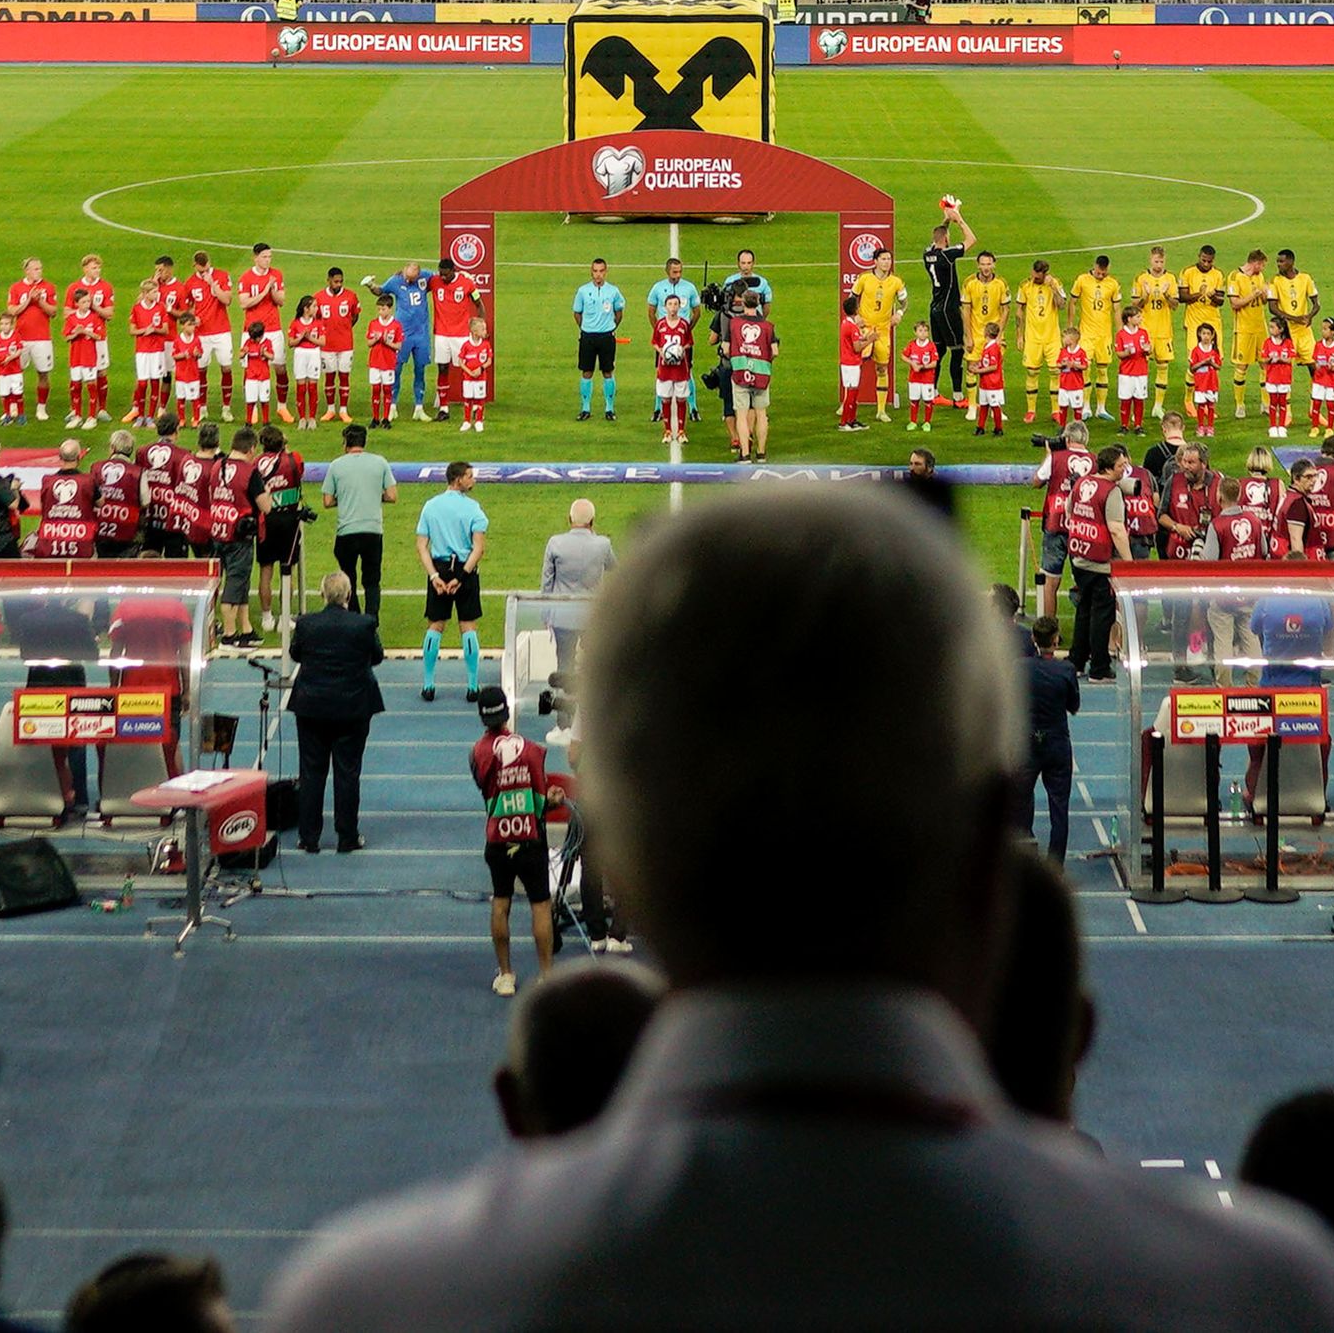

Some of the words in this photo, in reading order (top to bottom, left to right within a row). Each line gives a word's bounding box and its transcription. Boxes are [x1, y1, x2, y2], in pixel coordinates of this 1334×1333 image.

[312, 34, 412, 51] EUROPEAN
[417, 34, 524, 53] QUALIFIERS
[852, 36, 951, 53] EUROPEAN
[958, 36, 1063, 54] QUALIFIERS
[654, 158, 732, 172] EUROPEAN
[644, 173, 742, 190] QUALIFIERS
[410, 292, 421, 306] 12
[437, 288, 444, 301] 8
[874, 300, 881, 312] 3
[981, 304, 988, 316] 8
[1038, 306, 1045, 317] 2
[1092, 301, 1104, 311] 19
[1151, 300, 1162, 310] 18
[1291, 301, 1297, 312] 9
[43, 522, 86, 538] PHOTO
[1069, 519, 1098, 539] PHOTO
[51, 540, 79, 555] 115
[71, 698, 102, 711] PUMA
[1229, 698, 1258, 709] PUMA
[1279, 699, 1318, 707] ADMIRAL
[1292, 722, 1319, 732] UNIQA
[502, 793, 526, 813] HB
[498, 817, 532, 838] 004
